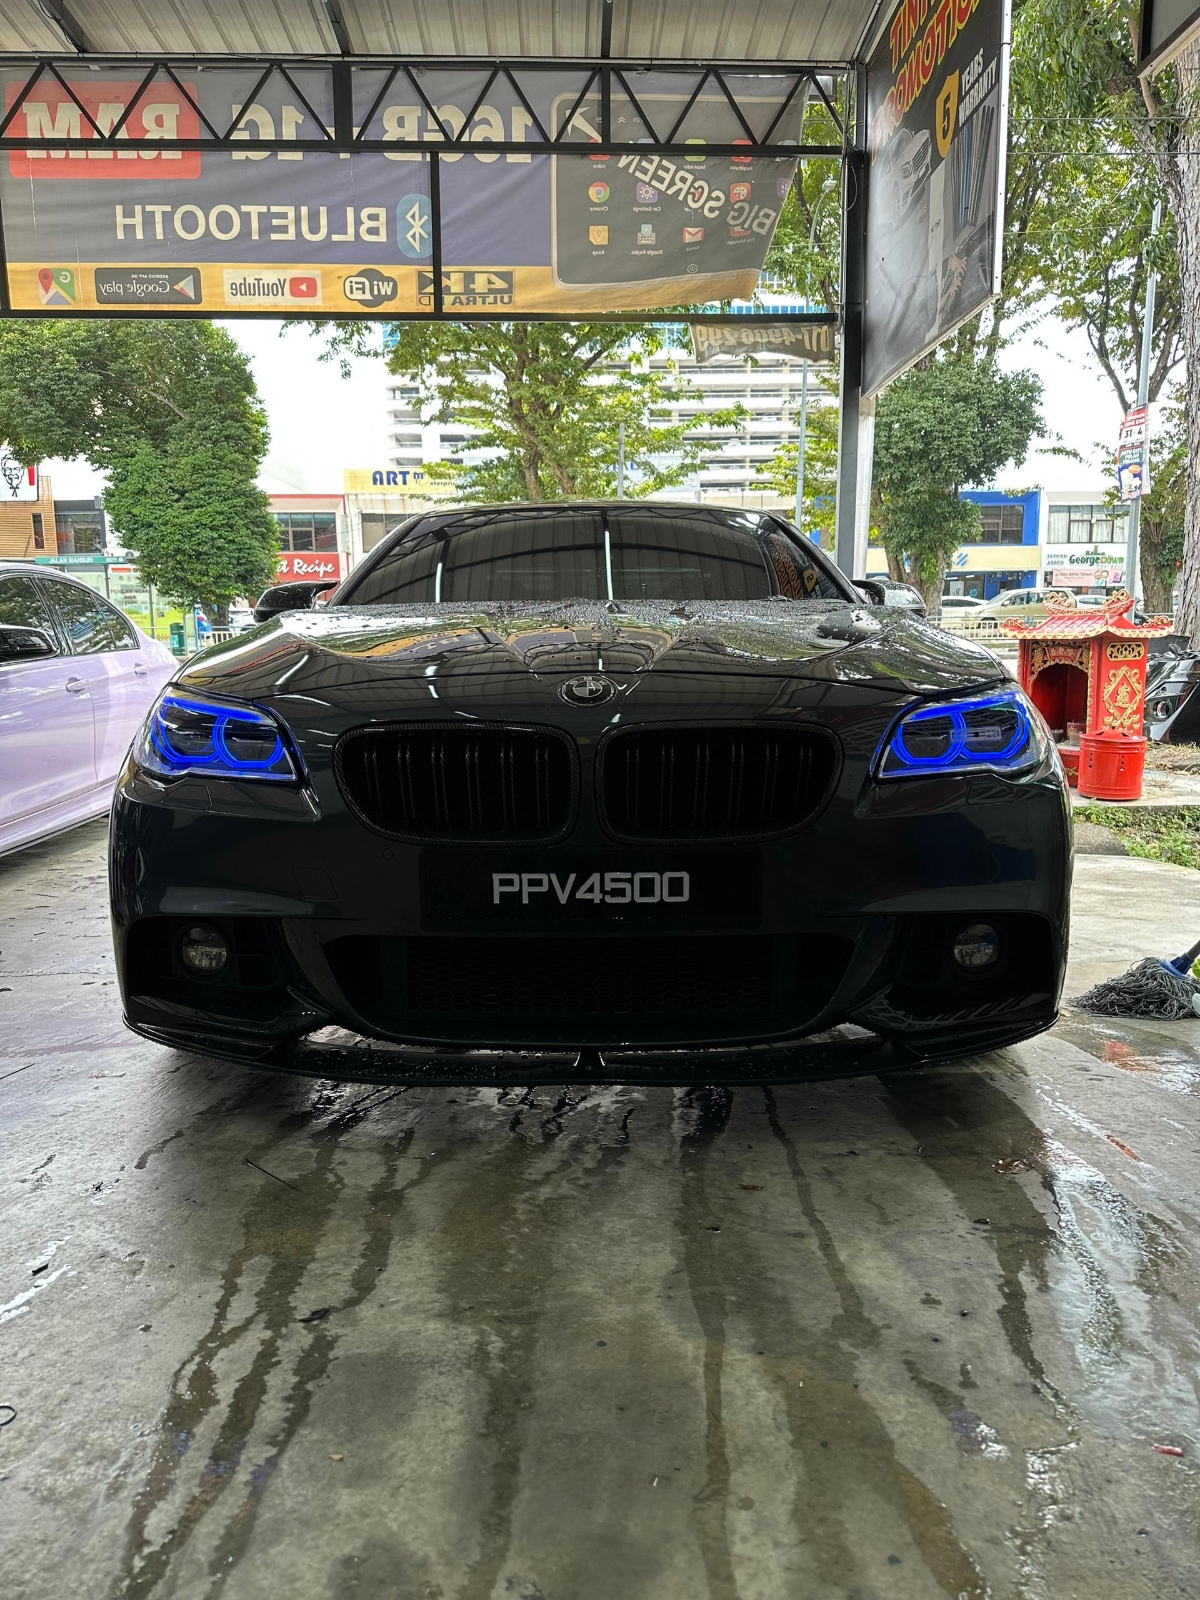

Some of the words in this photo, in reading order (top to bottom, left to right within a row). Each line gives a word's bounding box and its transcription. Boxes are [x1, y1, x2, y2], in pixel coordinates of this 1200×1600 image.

[872, 0, 980, 166] PROMOTIO
[959, 57, 997, 128] WARRANTY
[961, 48, 984, 96] YEARS
[942, 88, 951, 140] 5
[372, 470, 410, 485] ART
[293, 558, 335, 578] Recipe
[492, 871, 690, 904] PPV4500
